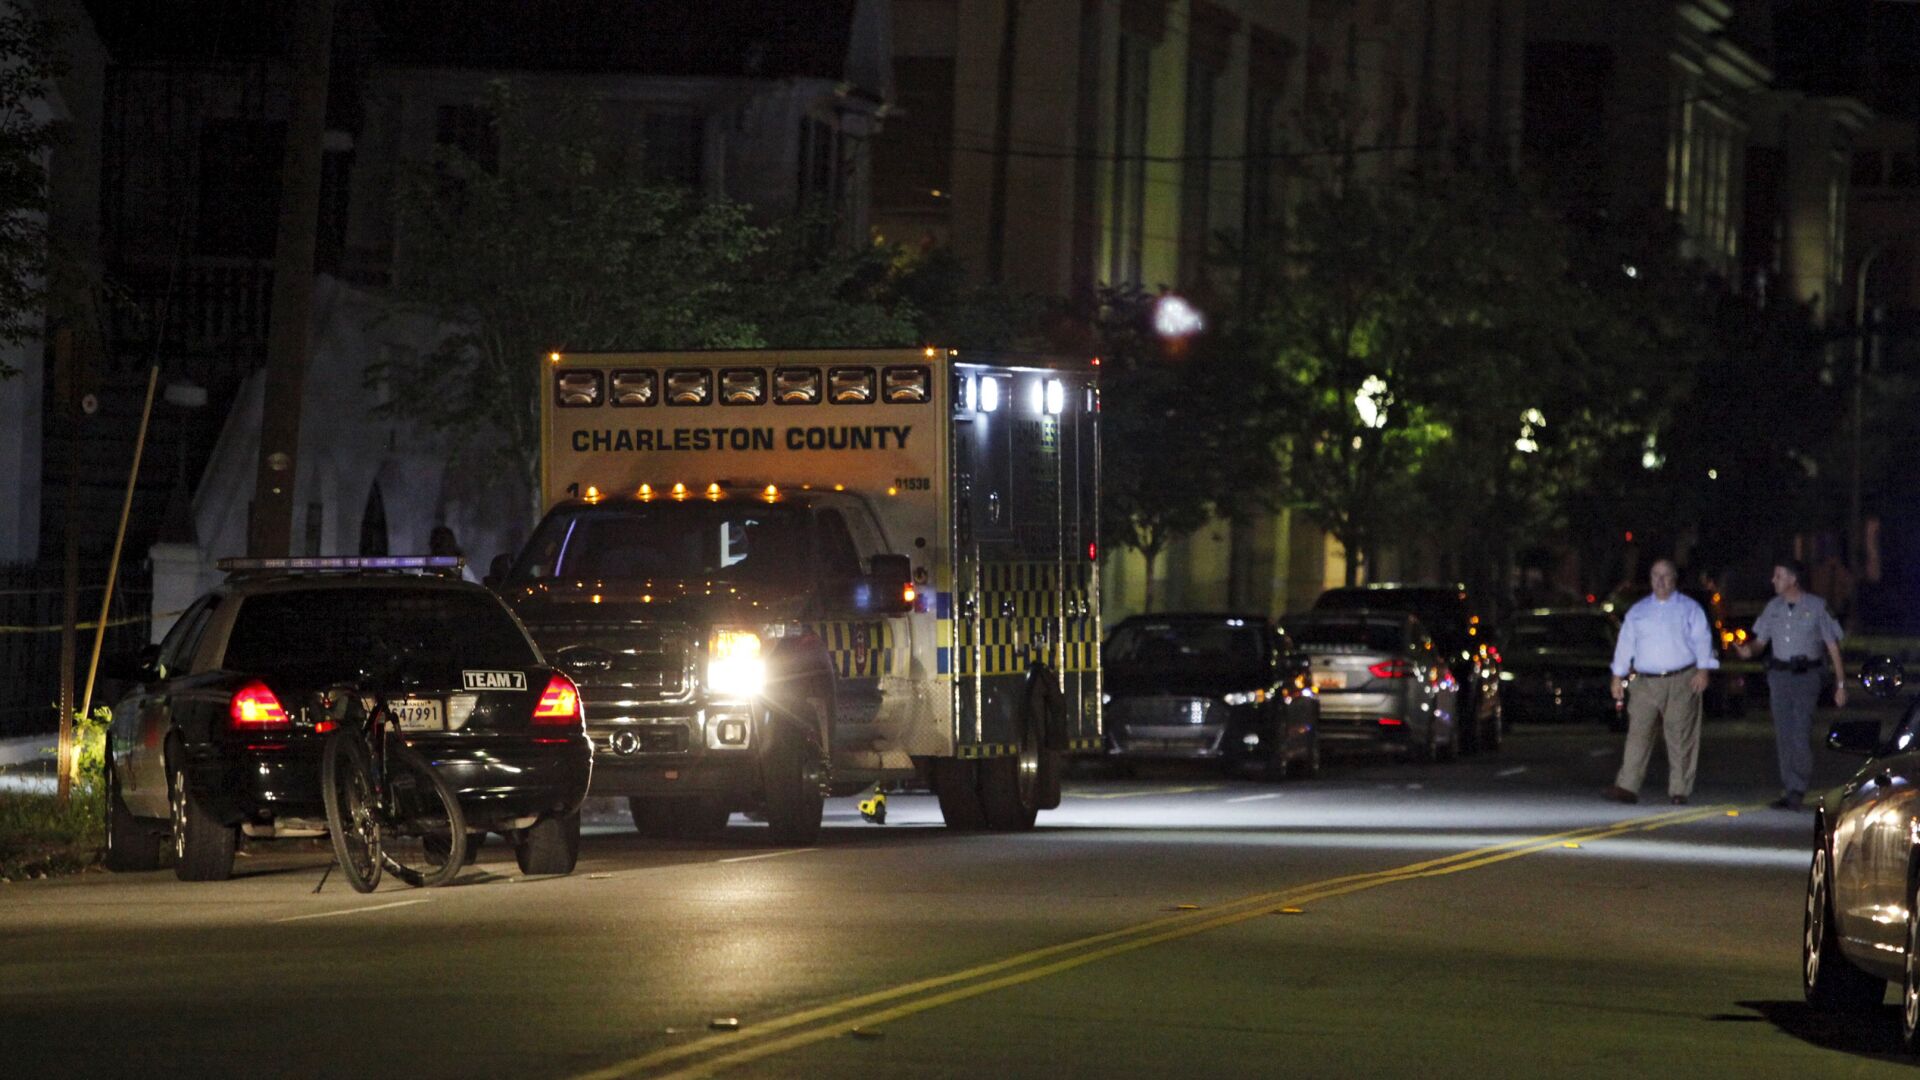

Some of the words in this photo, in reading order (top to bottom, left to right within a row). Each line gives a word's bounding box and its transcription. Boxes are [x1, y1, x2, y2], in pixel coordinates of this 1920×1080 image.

[572, 428, 773, 452] CHARLESTON
[786, 426, 912, 450] COUNTY
[465, 672, 511, 687] TEAM
[513, 673, 522, 688] 7
